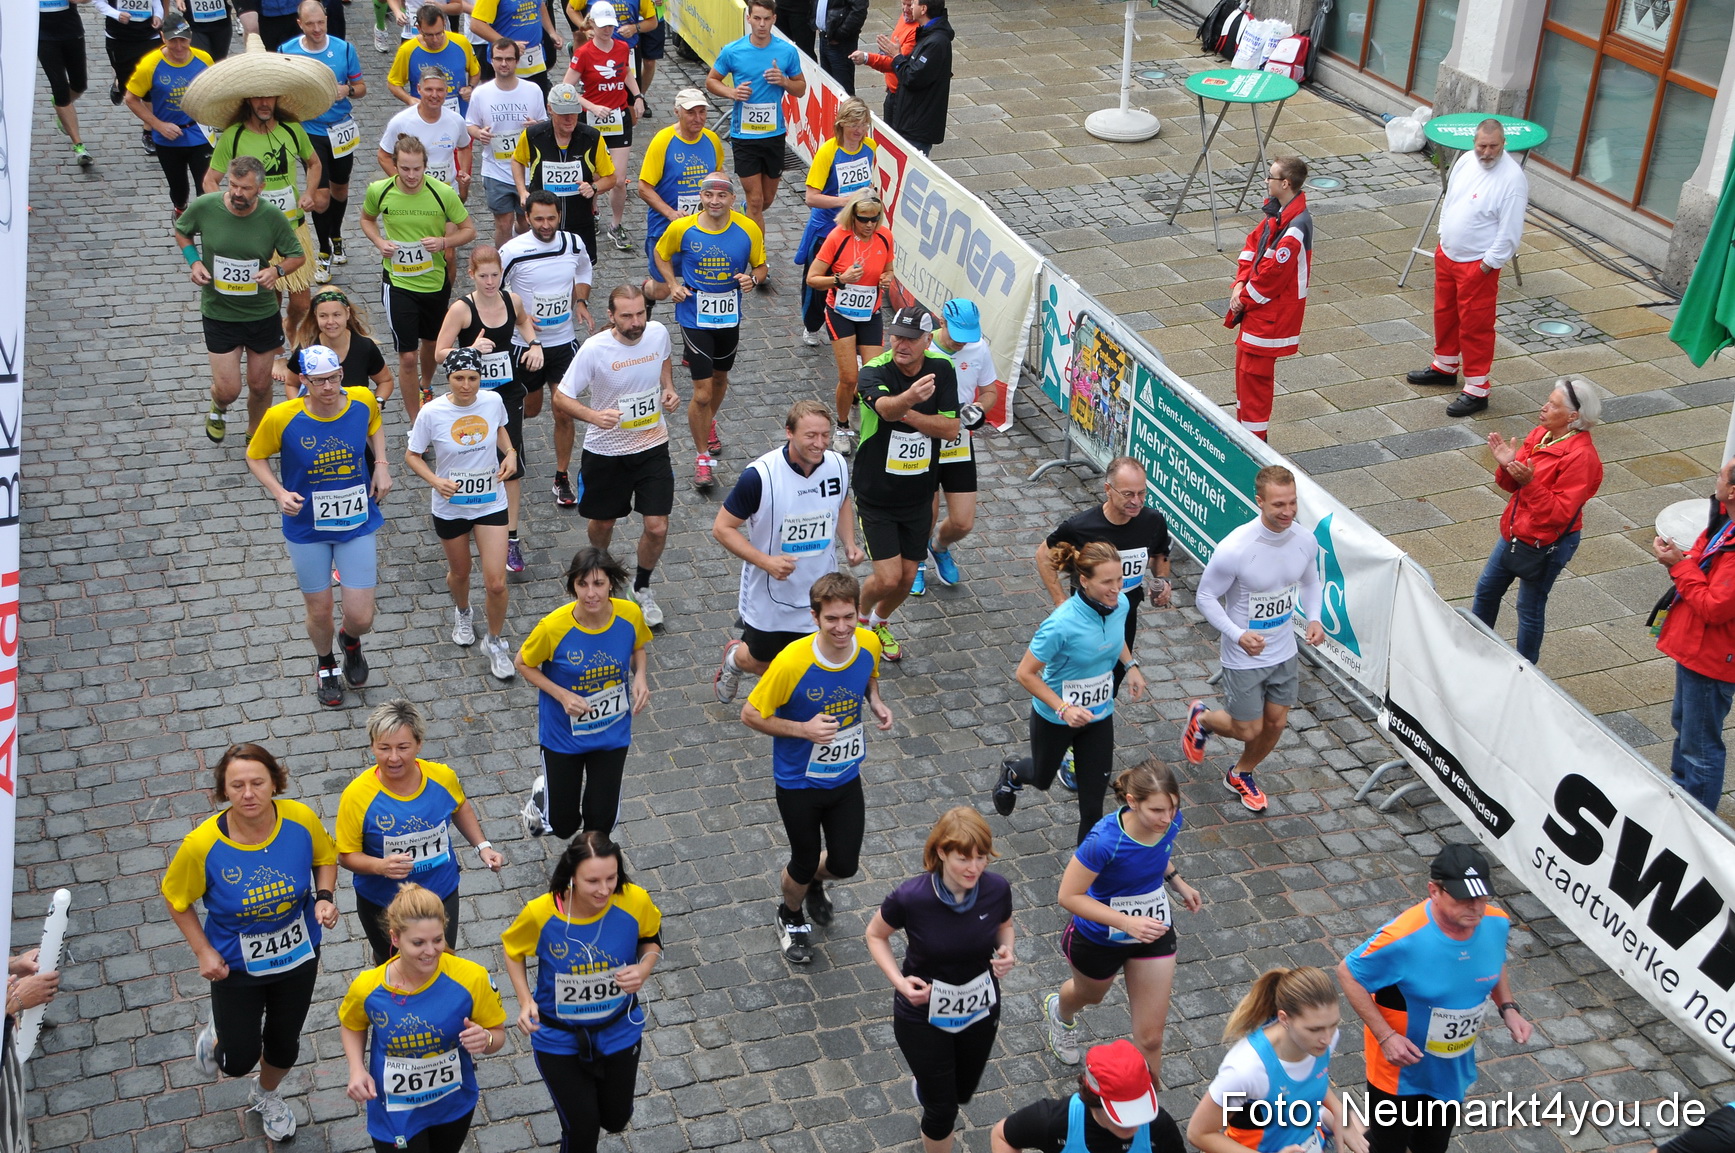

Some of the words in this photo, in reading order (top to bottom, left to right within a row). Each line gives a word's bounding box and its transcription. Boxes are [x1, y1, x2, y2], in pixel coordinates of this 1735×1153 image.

[121, 0, 150, 10] 2924
[195, 0, 222, 12] 2840
[527, 54, 533, 66] 9
[490, 103, 528, 112] NOVINA
[492, 113, 528, 122] HOTELS
[748, 111, 770, 123] 252
[337, 127, 355, 145] 207
[502, 137, 517, 150] 31
[547, 170, 579, 184] 2522
[841, 166, 869, 185] 2265
[554, 185, 573, 193] Hubert
[900, 167, 1017, 298] Egner
[397, 248, 424, 264] 214
[223, 267, 251, 283] 233
[227, 284, 244, 292] Peter
[536, 299, 569, 317] 2762
[702, 299, 734, 314] 2106
[839, 292, 873, 308] 2902
[480, 361, 507, 379] 461
[611, 351, 656, 372] Continental
[630, 397, 656, 418] 154
[1158, 396, 1226, 464] Event-Leit-Systeme
[898, 441, 926, 459] 296
[902, 461, 919, 470] Horst
[1136, 417, 1165, 458] Mehr
[1168, 445, 1227, 514] Sicherheit
[455, 476, 493, 495] 2091
[819, 477, 842, 498] 13
[1133, 443, 1150, 472] für
[1152, 459, 1169, 488] Ihr
[1170, 477, 1208, 526] Event!
[320, 496, 364, 519] 2174
[465, 496, 482, 505] Julia
[334, 518, 351, 527] Jörg
[787, 520, 827, 542] 2571
[1180, 523, 1197, 548] Line:
[792, 542, 821, 552] Christian
[1122, 560, 1142, 577] 05
[1254, 594, 1293, 619] 2804
[1340, 650, 1361, 674] GmbH
[1069, 683, 1110, 708] 2646
[817, 738, 860, 762] 2916
[1434, 755, 1451, 776] die
[1451, 771, 1499, 828] verbinden
[409, 832, 440, 844] Neumarkt
[1532, 846, 1680, 993] stadtwerke
[249, 923, 304, 960] 2443
[269, 955, 294, 968] Mara
[563, 980, 621, 1003] 2498
[573, 1001, 612, 1015] Jennifer
[937, 989, 991, 1015] 2424
[386, 1061, 410, 1072] PARTL
[411, 1058, 447, 1071] Neumarkt
[392, 1065, 455, 1094] 2675
[405, 1089, 444, 1105] Martina
